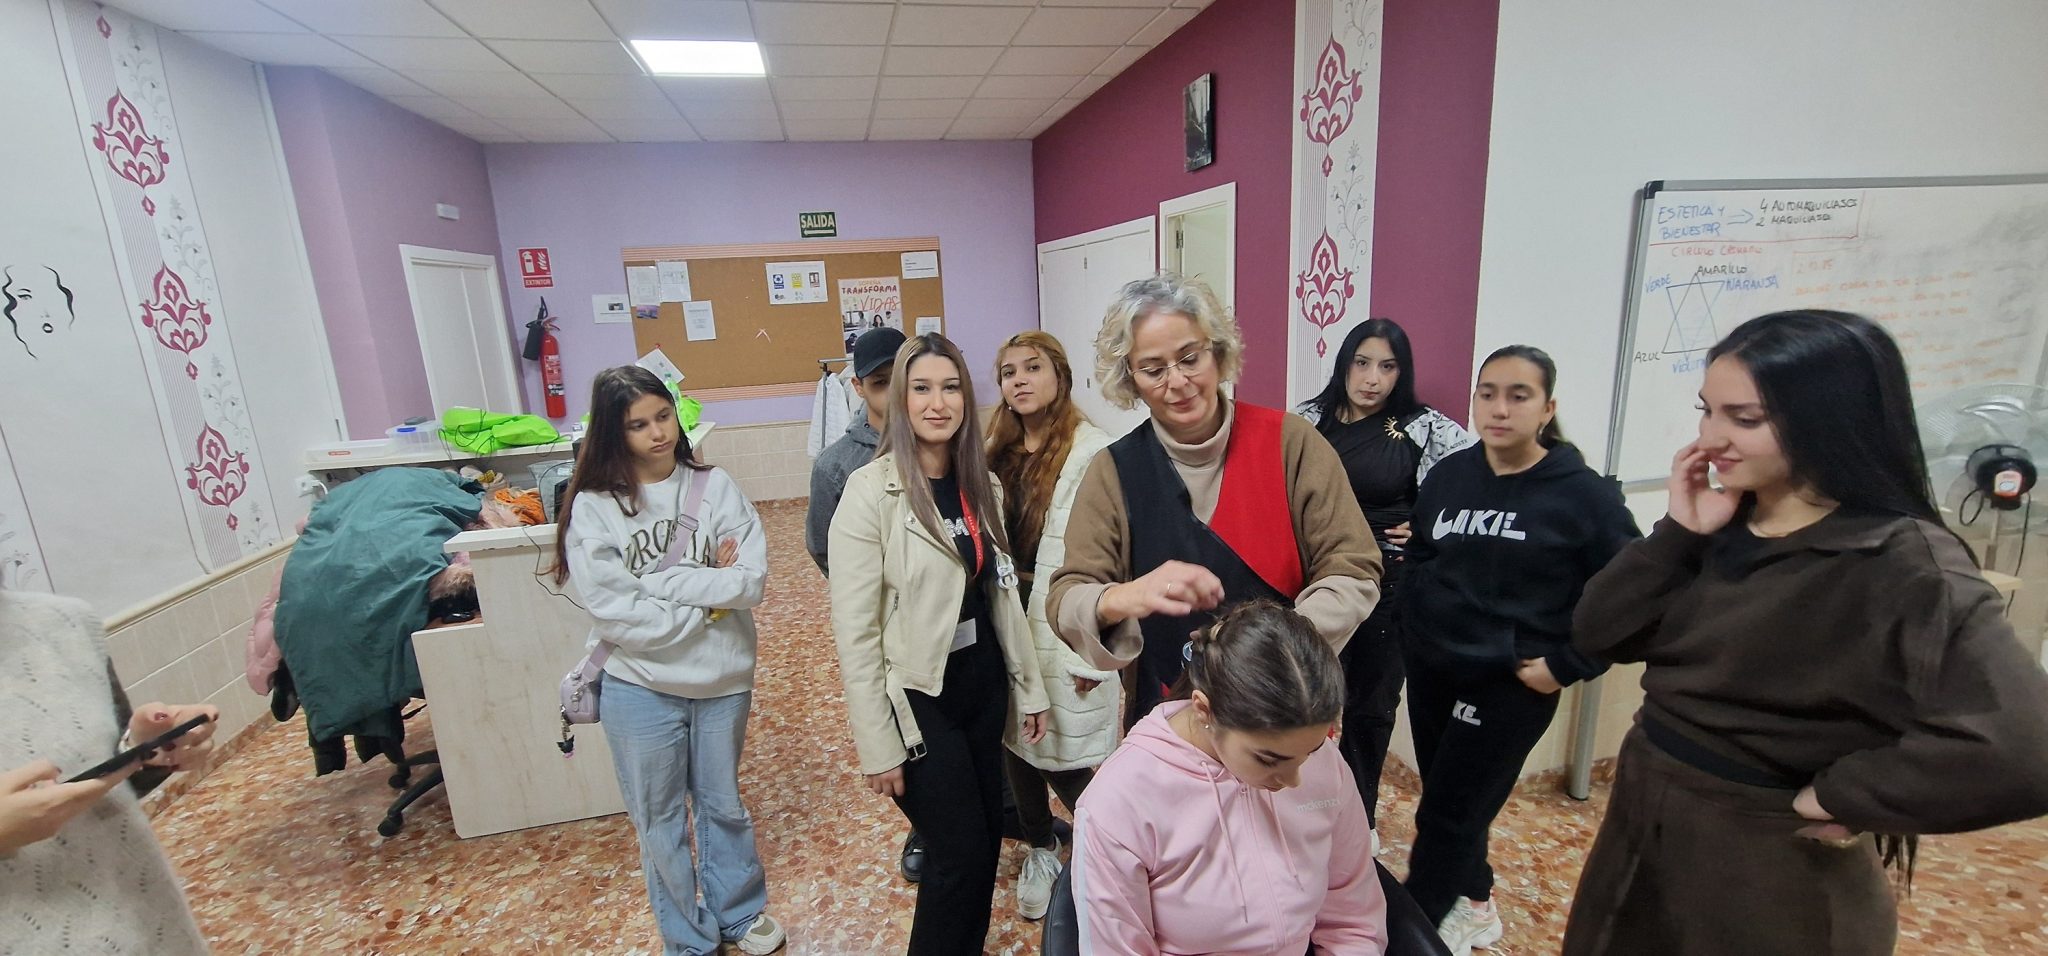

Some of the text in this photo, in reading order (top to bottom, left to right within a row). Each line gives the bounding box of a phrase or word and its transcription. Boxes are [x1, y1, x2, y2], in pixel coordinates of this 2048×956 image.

[1760, 198, 1768, 210] 4
[801, 215, 835, 228] SALIDA
[1755, 217, 1765, 227] 2
[1661, 221, 1721, 239] BIENESTAR
[1696, 264, 1748, 277] AMARILLO
[1645, 273, 1672, 294] VERDE
[1726, 274, 1780, 291] NARANJA
[841, 285, 897, 294] TRANSFORMA
[860, 295, 901, 313] VIDAS
